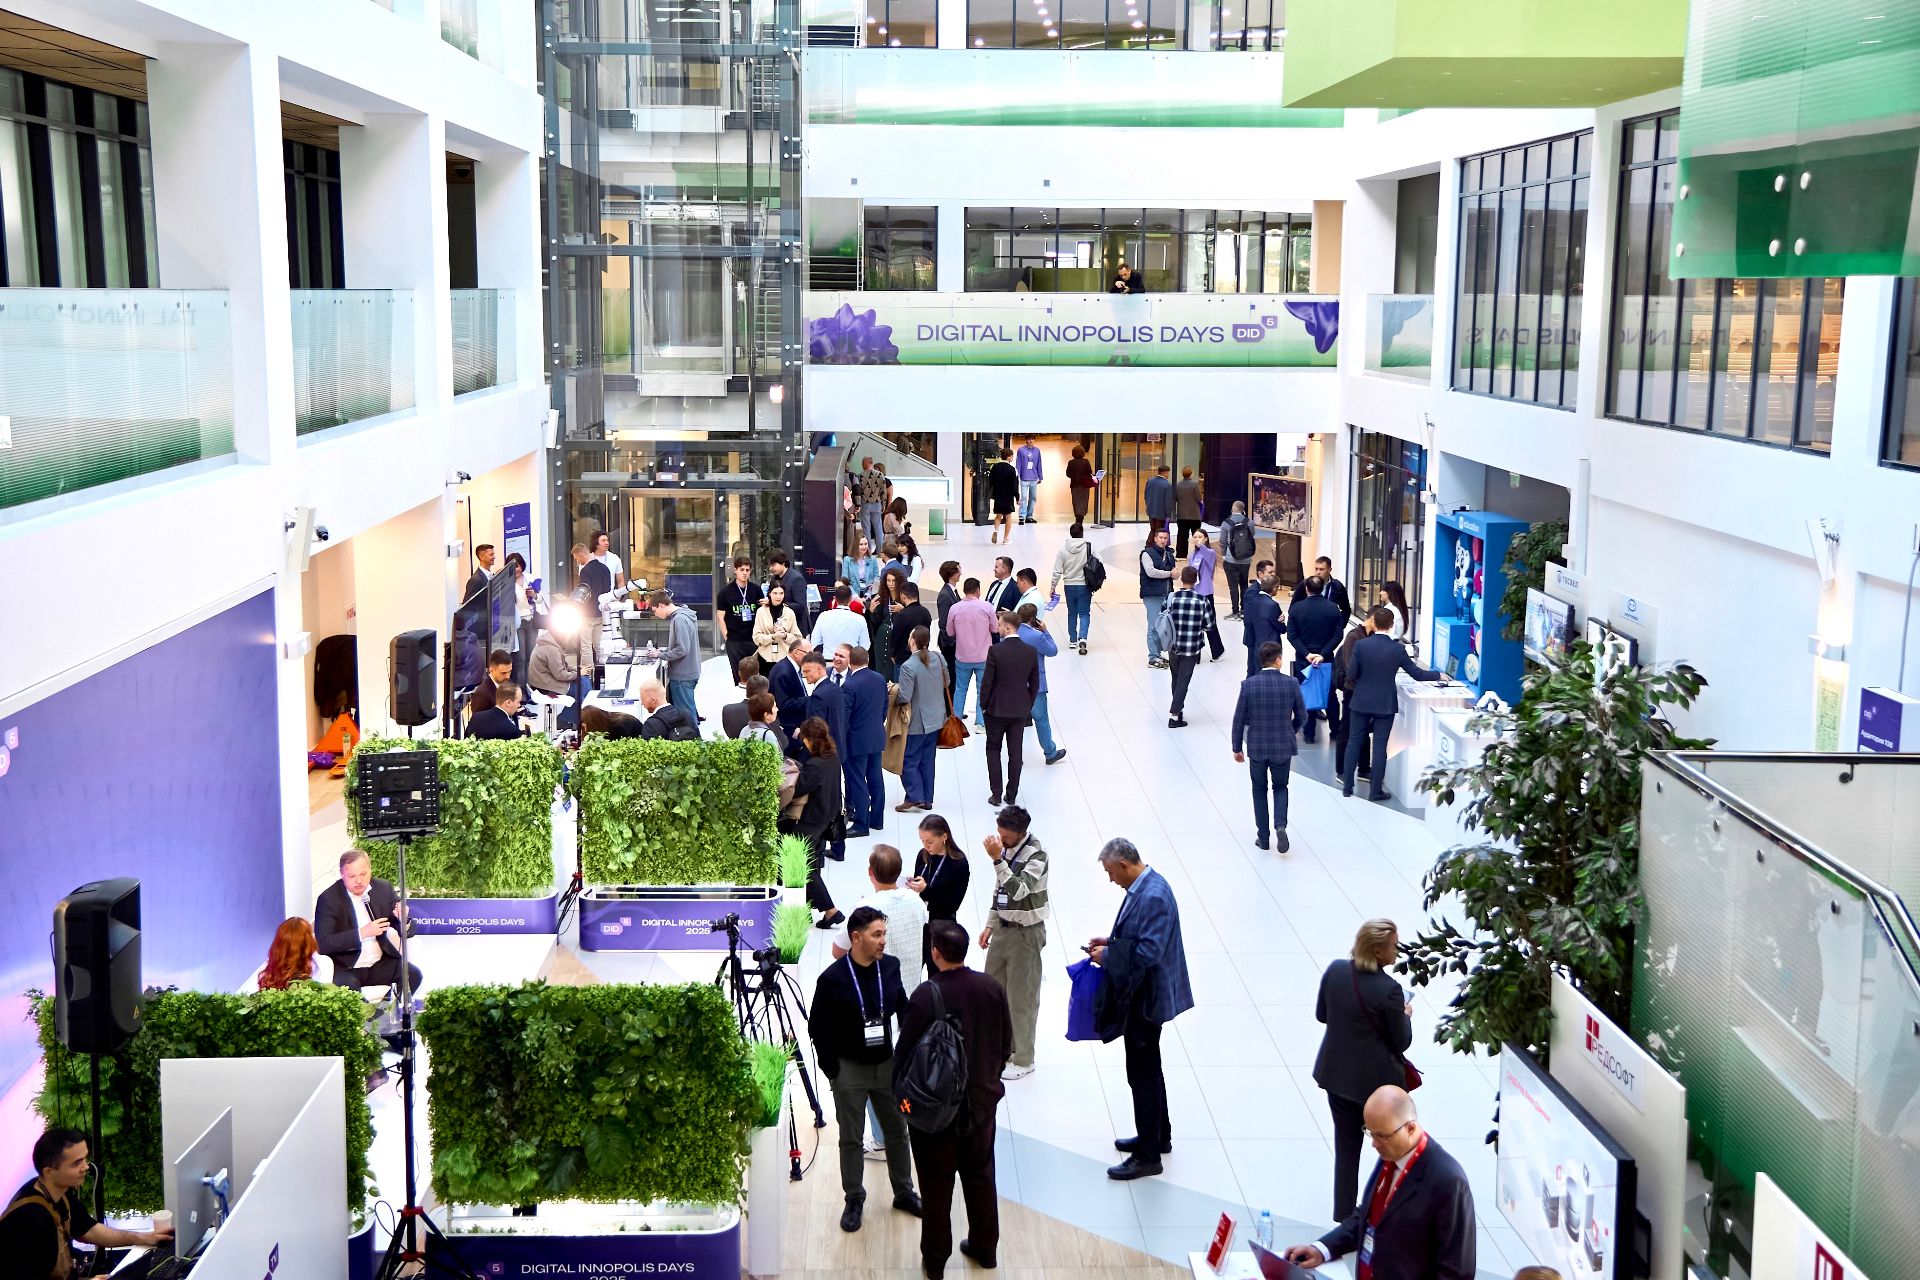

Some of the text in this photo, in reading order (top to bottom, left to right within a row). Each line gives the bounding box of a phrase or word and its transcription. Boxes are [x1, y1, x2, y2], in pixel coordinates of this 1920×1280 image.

[1236, 317, 1275, 339] DID 5
[917, 324, 1225, 343] DIGITAL INNOPOLIS DAYS
[449, 918, 499, 926] INNOPOLIS
[500, 918, 525, 926] DAYS
[641, 919, 678, 927] DIGITAL
[456, 926, 482, 934] 2025
[603, 925, 620, 933] DID
[686, 927, 711, 935] 2025
[1591, 1038, 1635, 1091] РЕДСОФТ
[492, 1263, 500, 1272] 5
[521, 1263, 695, 1274] DIGITAL INNOPOLIS DAYS
